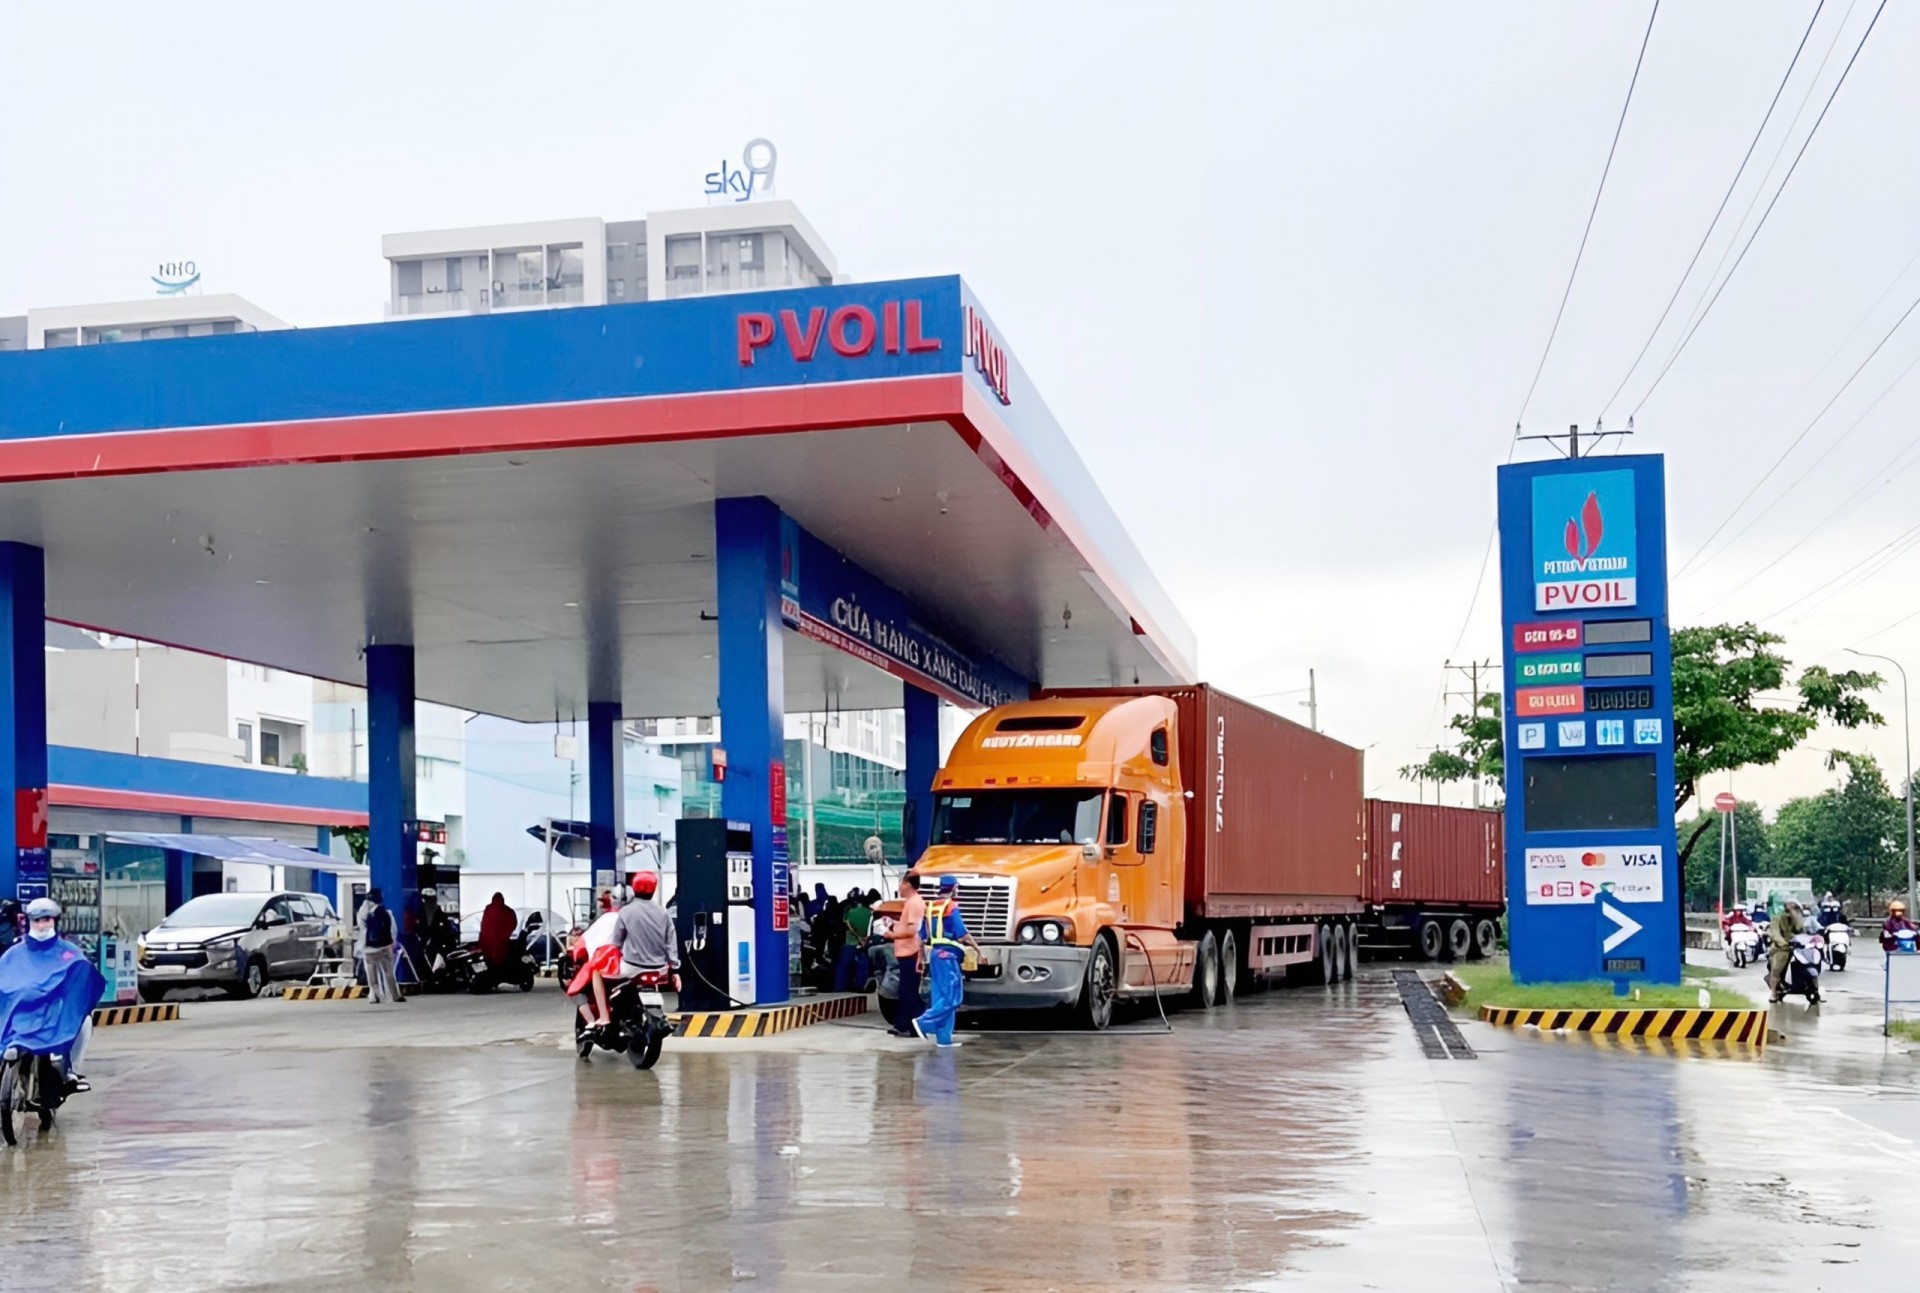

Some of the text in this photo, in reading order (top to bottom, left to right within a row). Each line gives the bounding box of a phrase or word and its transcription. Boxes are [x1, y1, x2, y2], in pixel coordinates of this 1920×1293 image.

[737, 299, 942, 367] PVOIL
[1545, 582, 1628, 605] PVOIL
[1621, 853, 1658, 867] VISA
